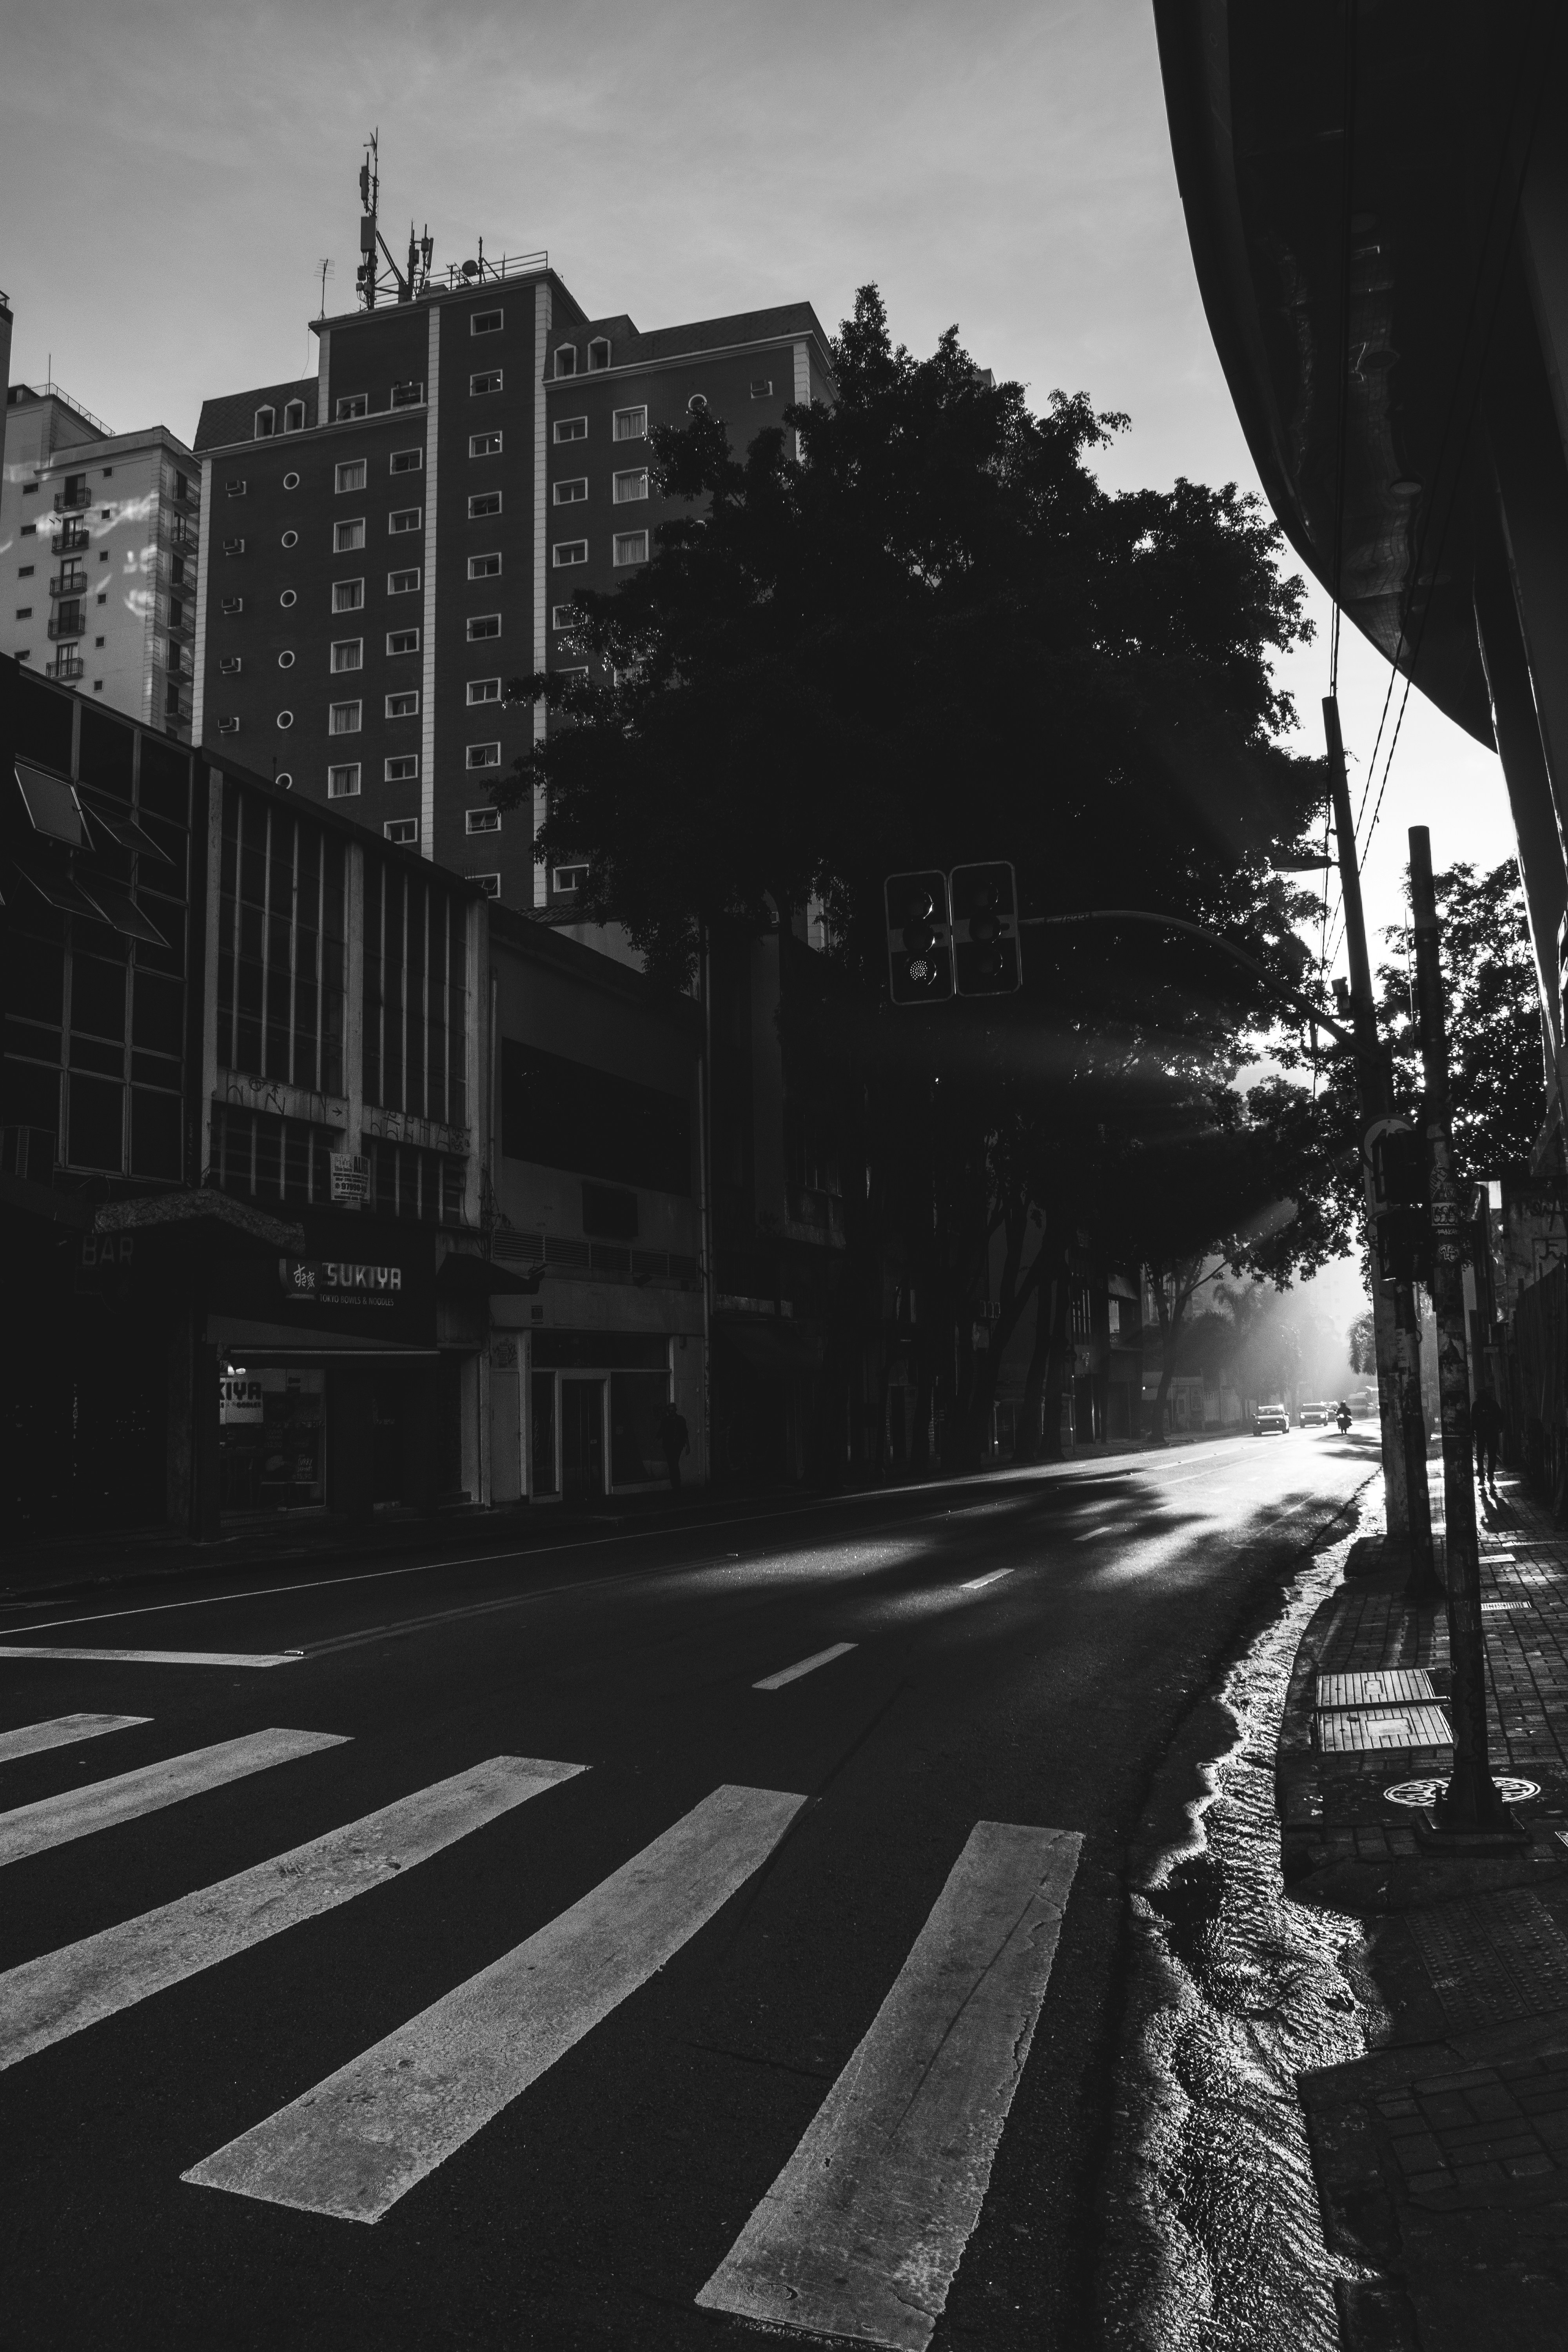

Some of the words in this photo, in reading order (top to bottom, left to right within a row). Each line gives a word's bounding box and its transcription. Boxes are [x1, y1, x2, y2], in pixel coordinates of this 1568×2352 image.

[341, 1183, 367, 1193] 97990-
[82, 1235, 134, 1267] BAR
[327, 1263, 401, 1290] SUKIYA
[320, 1294, 339, 1303] TOKYO
[341, 1295, 361, 1305] BOWLS
[368, 1297, 394, 1306] NOODLES
